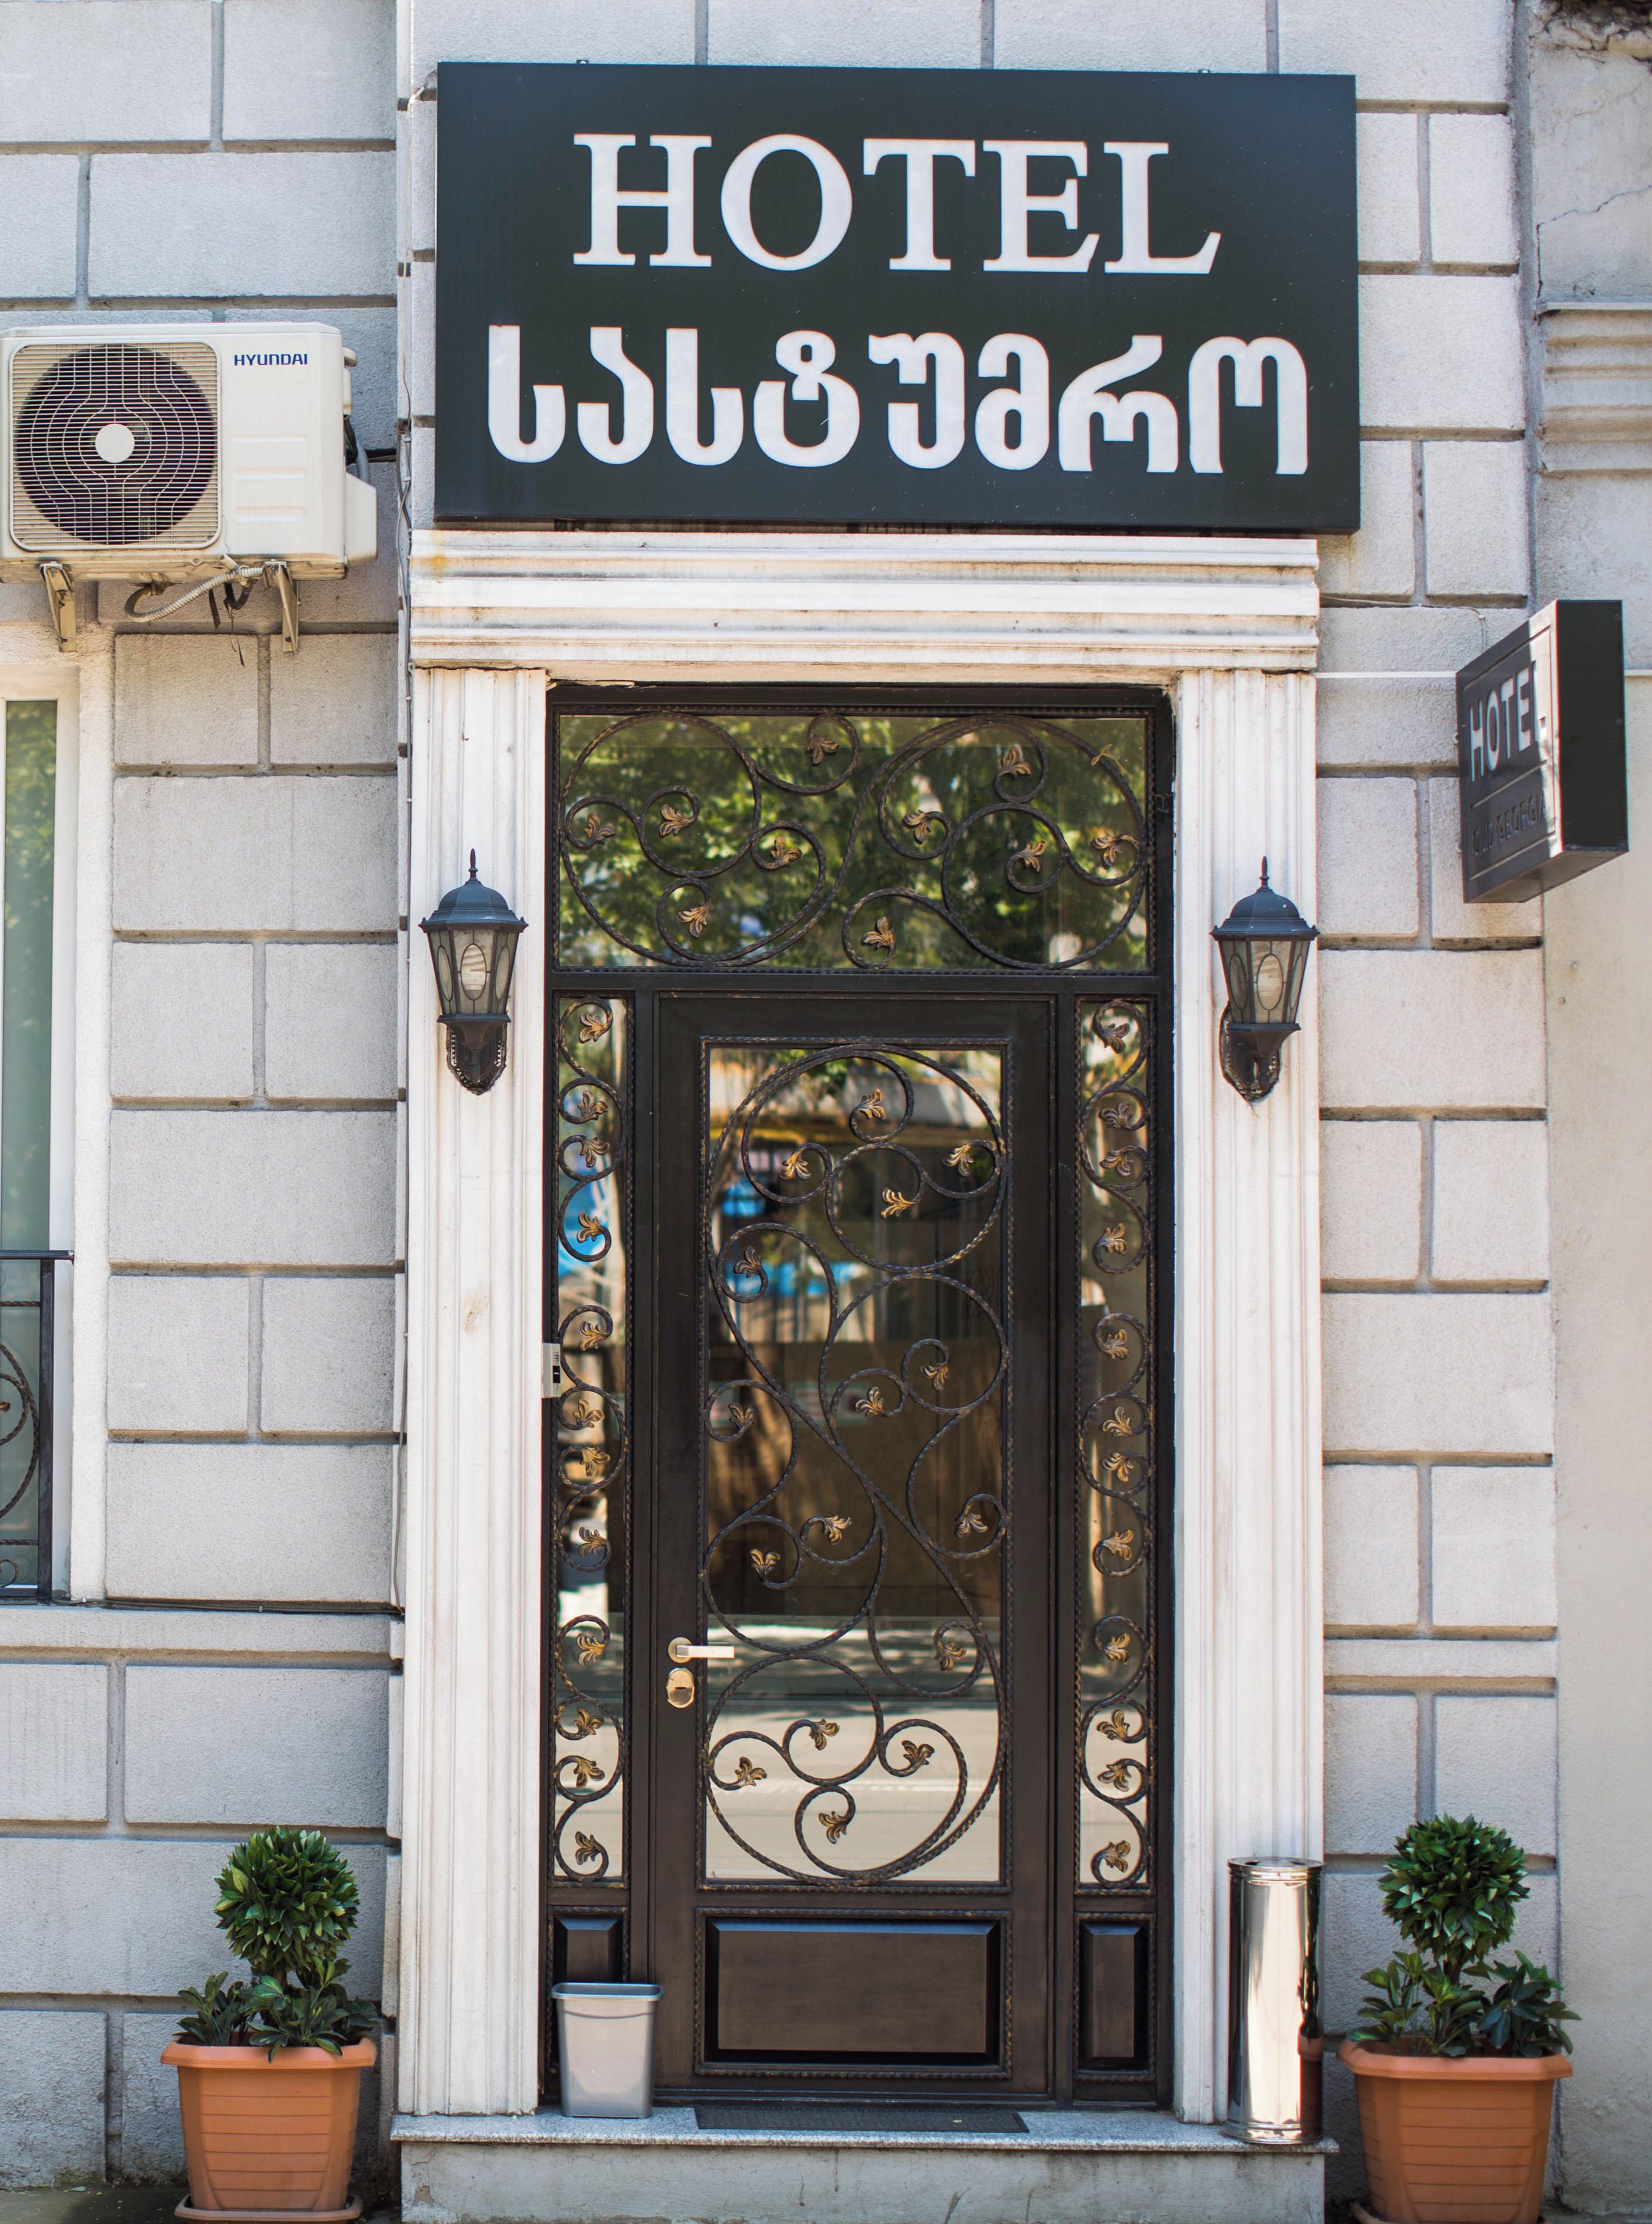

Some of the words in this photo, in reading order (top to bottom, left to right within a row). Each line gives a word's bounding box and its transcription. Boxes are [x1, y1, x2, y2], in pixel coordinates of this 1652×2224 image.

[573, 133, 1221, 274] HOTEL
[233, 353, 308, 366] HYUNDAI
[488, 324, 1308, 475] სასტუმრო
[1469, 659, 1547, 783] HOTEL
[1471, 821, 1494, 857] OLD
